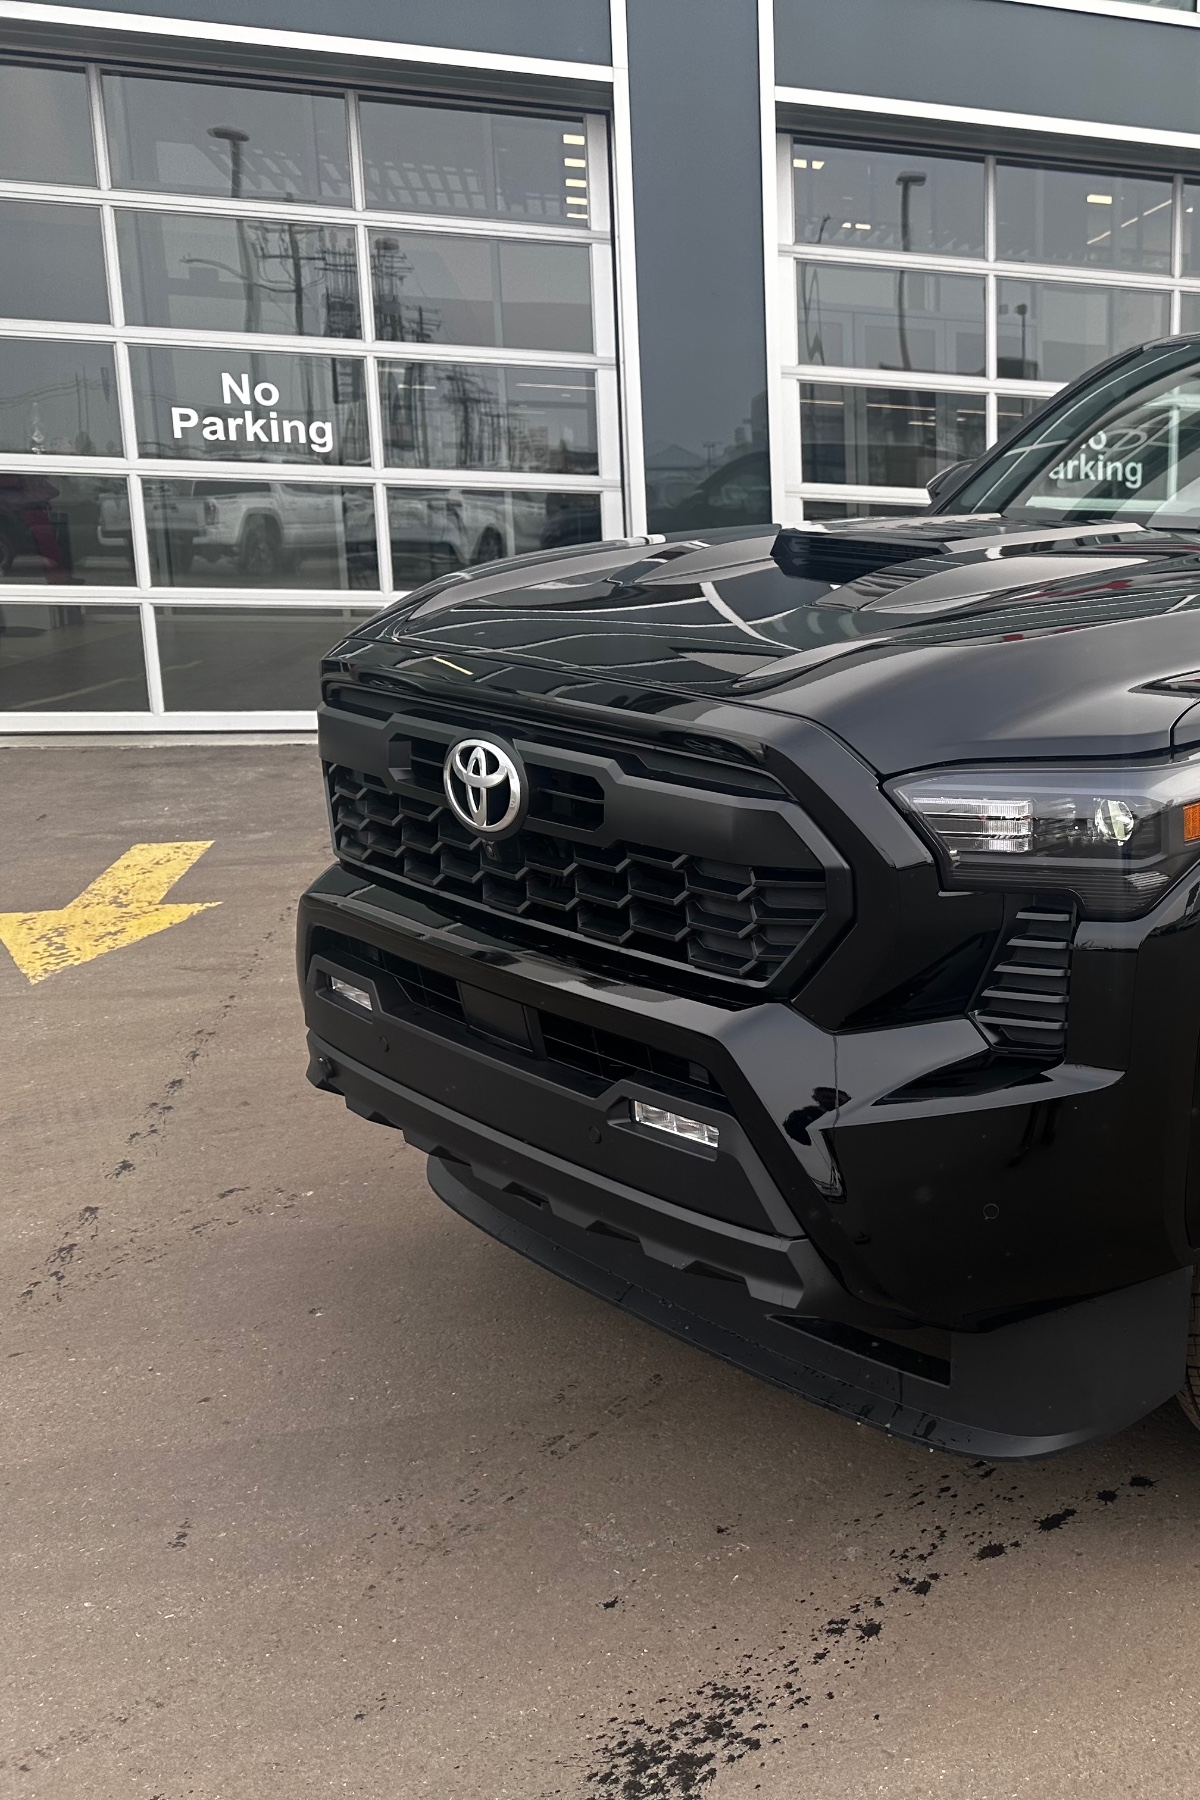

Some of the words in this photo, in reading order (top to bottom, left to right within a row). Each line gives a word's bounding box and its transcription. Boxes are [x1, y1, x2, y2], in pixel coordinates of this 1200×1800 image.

[221, 372, 280, 407] No
[171, 406, 334, 453] Parking
[1049, 453, 1142, 489] arking
